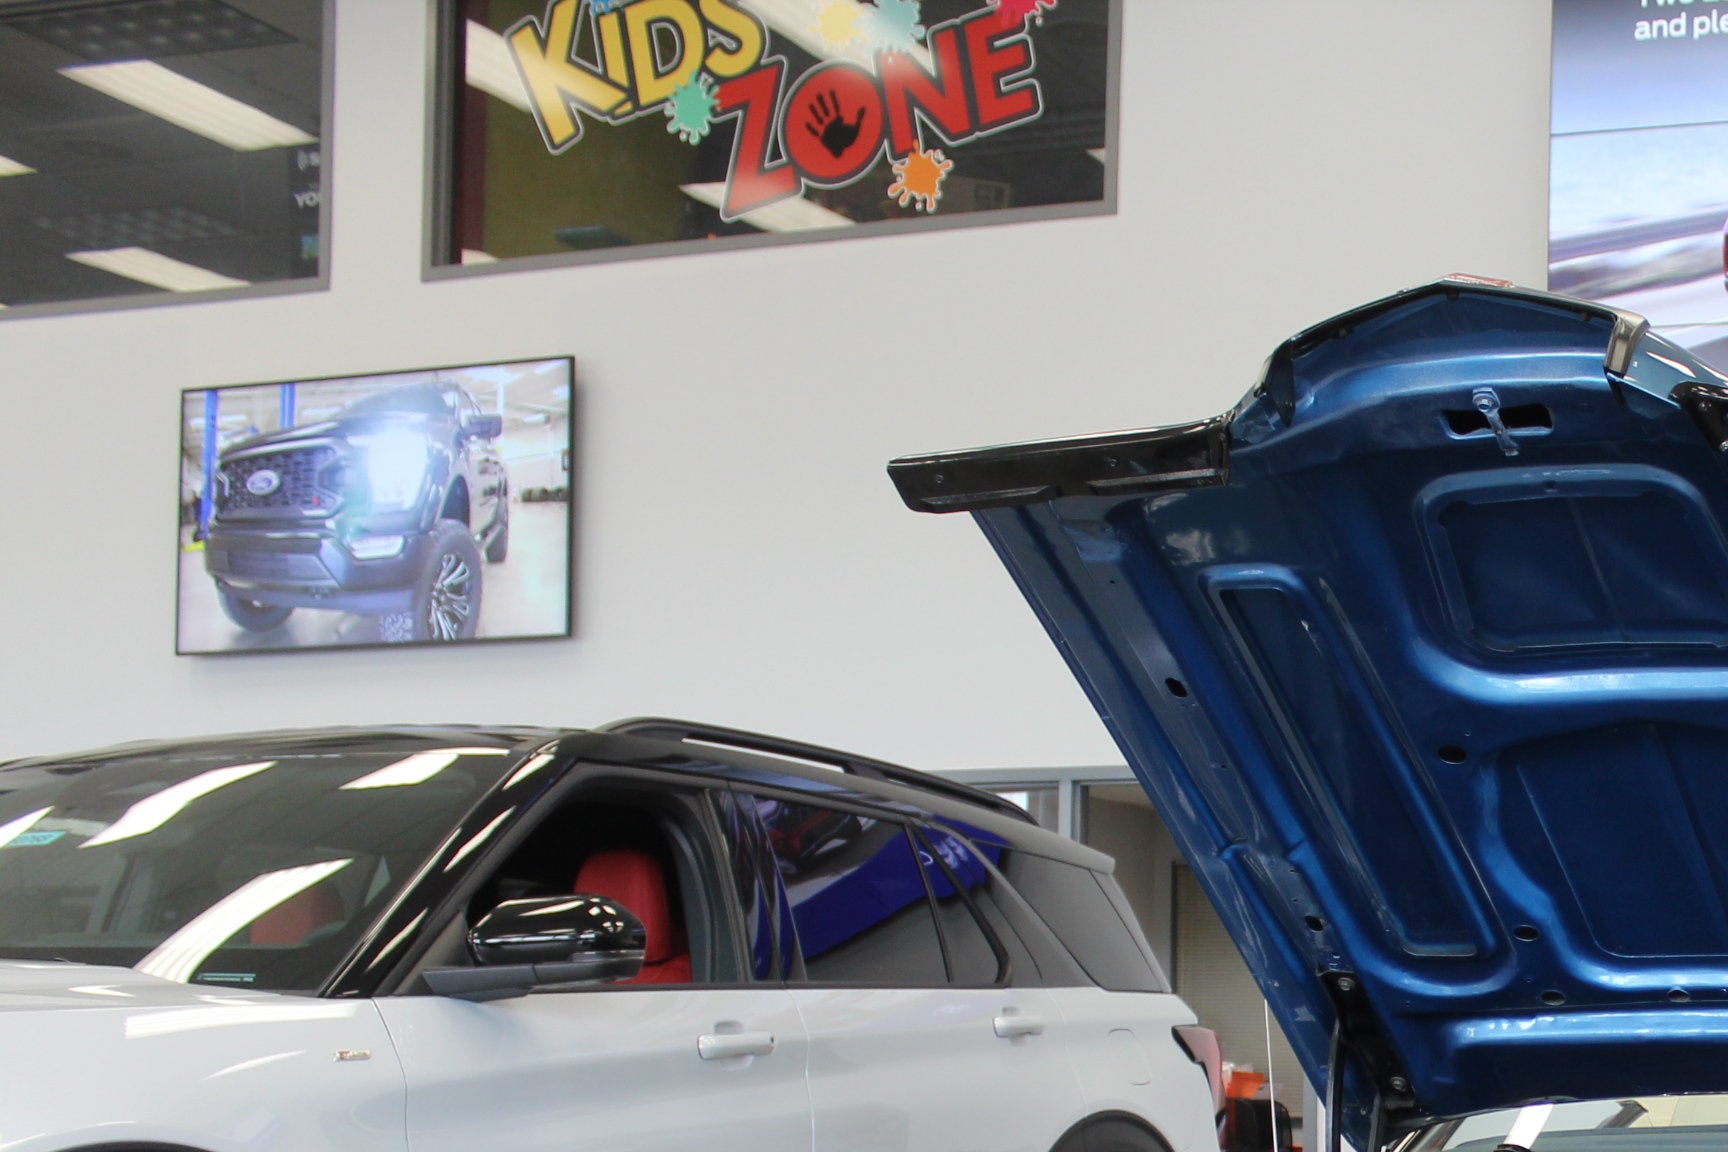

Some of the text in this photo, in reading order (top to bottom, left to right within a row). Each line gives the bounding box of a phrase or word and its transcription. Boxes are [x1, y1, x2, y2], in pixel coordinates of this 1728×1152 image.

[506, 0, 769, 154] KIDS
[1634, 11, 1687, 41] and
[717, 8, 1043, 220] ZONE
